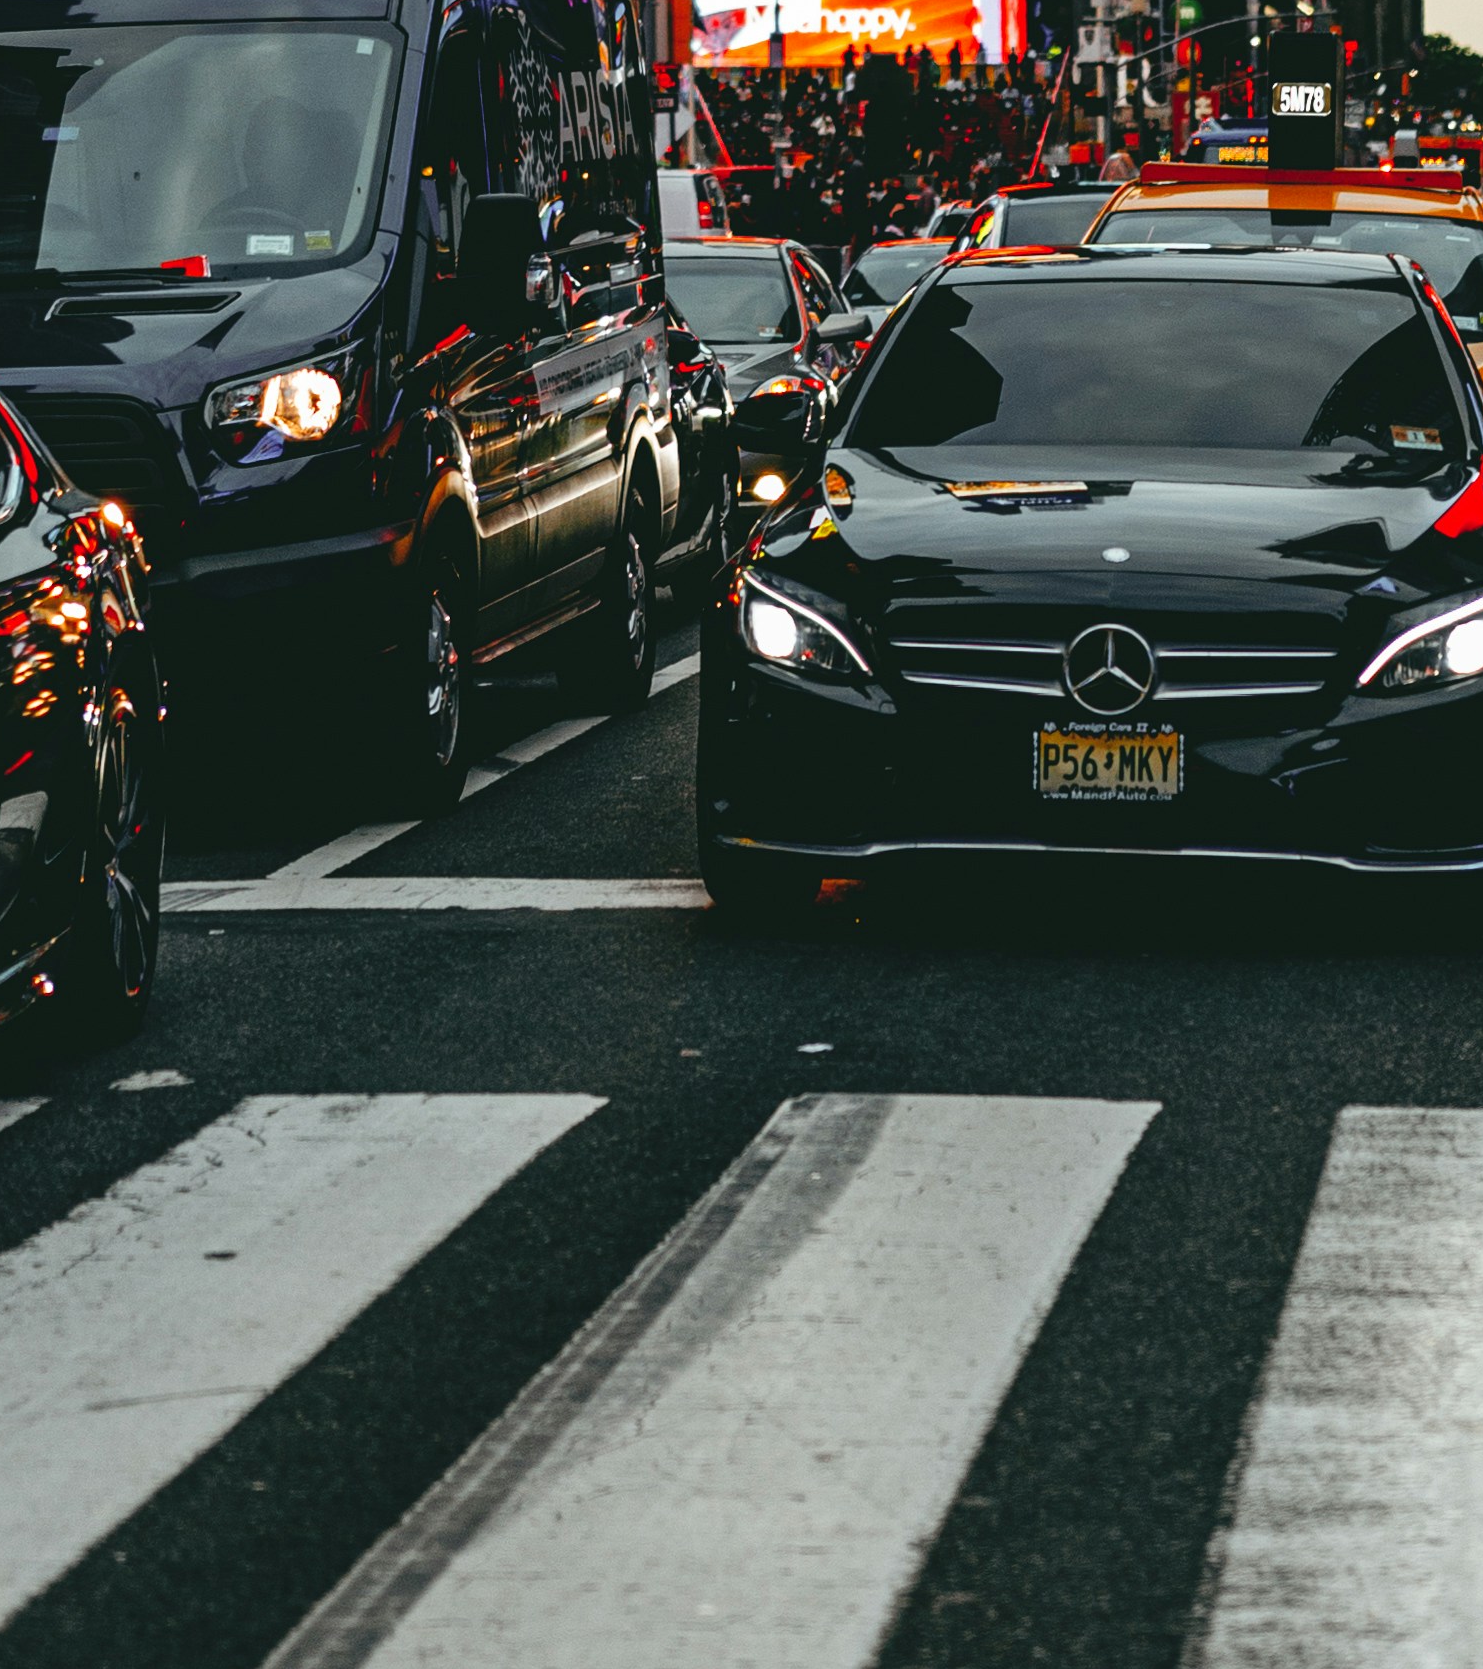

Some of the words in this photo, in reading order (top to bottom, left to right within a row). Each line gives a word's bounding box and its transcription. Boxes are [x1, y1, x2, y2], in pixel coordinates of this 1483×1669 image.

[1280, 85, 1325, 114] 5M78
[1042, 743, 1099, 781] P56
[1118, 745, 1174, 783] MKY
